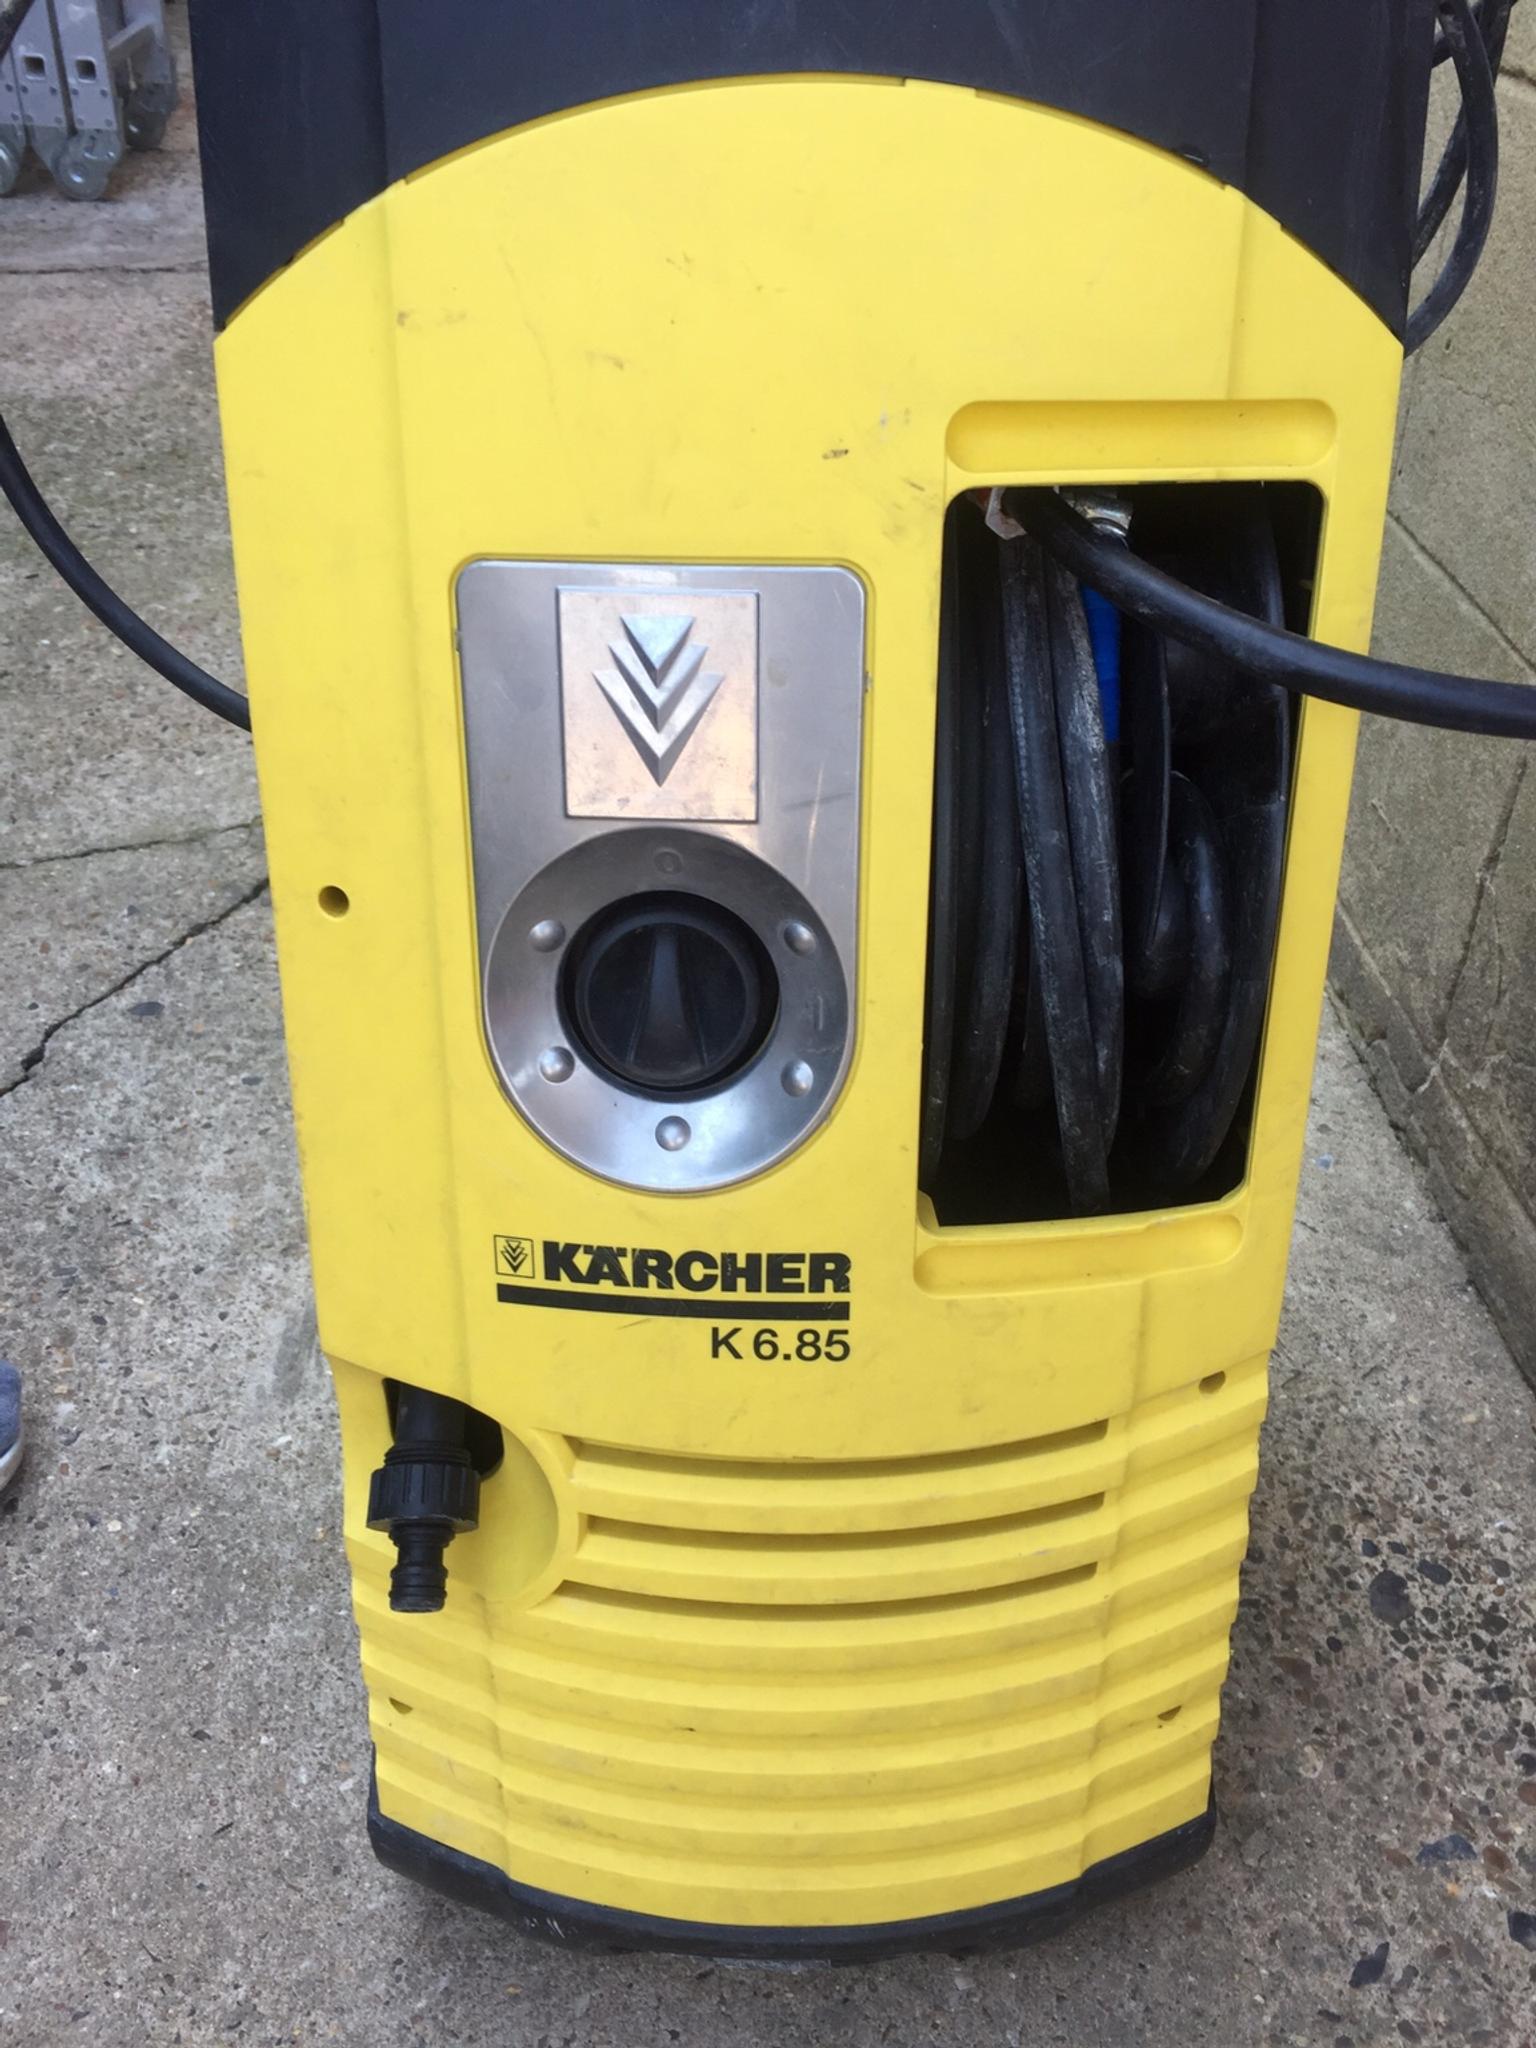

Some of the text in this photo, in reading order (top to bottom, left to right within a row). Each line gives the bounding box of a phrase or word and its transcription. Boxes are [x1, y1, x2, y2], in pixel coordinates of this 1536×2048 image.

[542, 1240, 852, 1294] KÄRCHER
[711, 1326, 852, 1362] K 6.85
